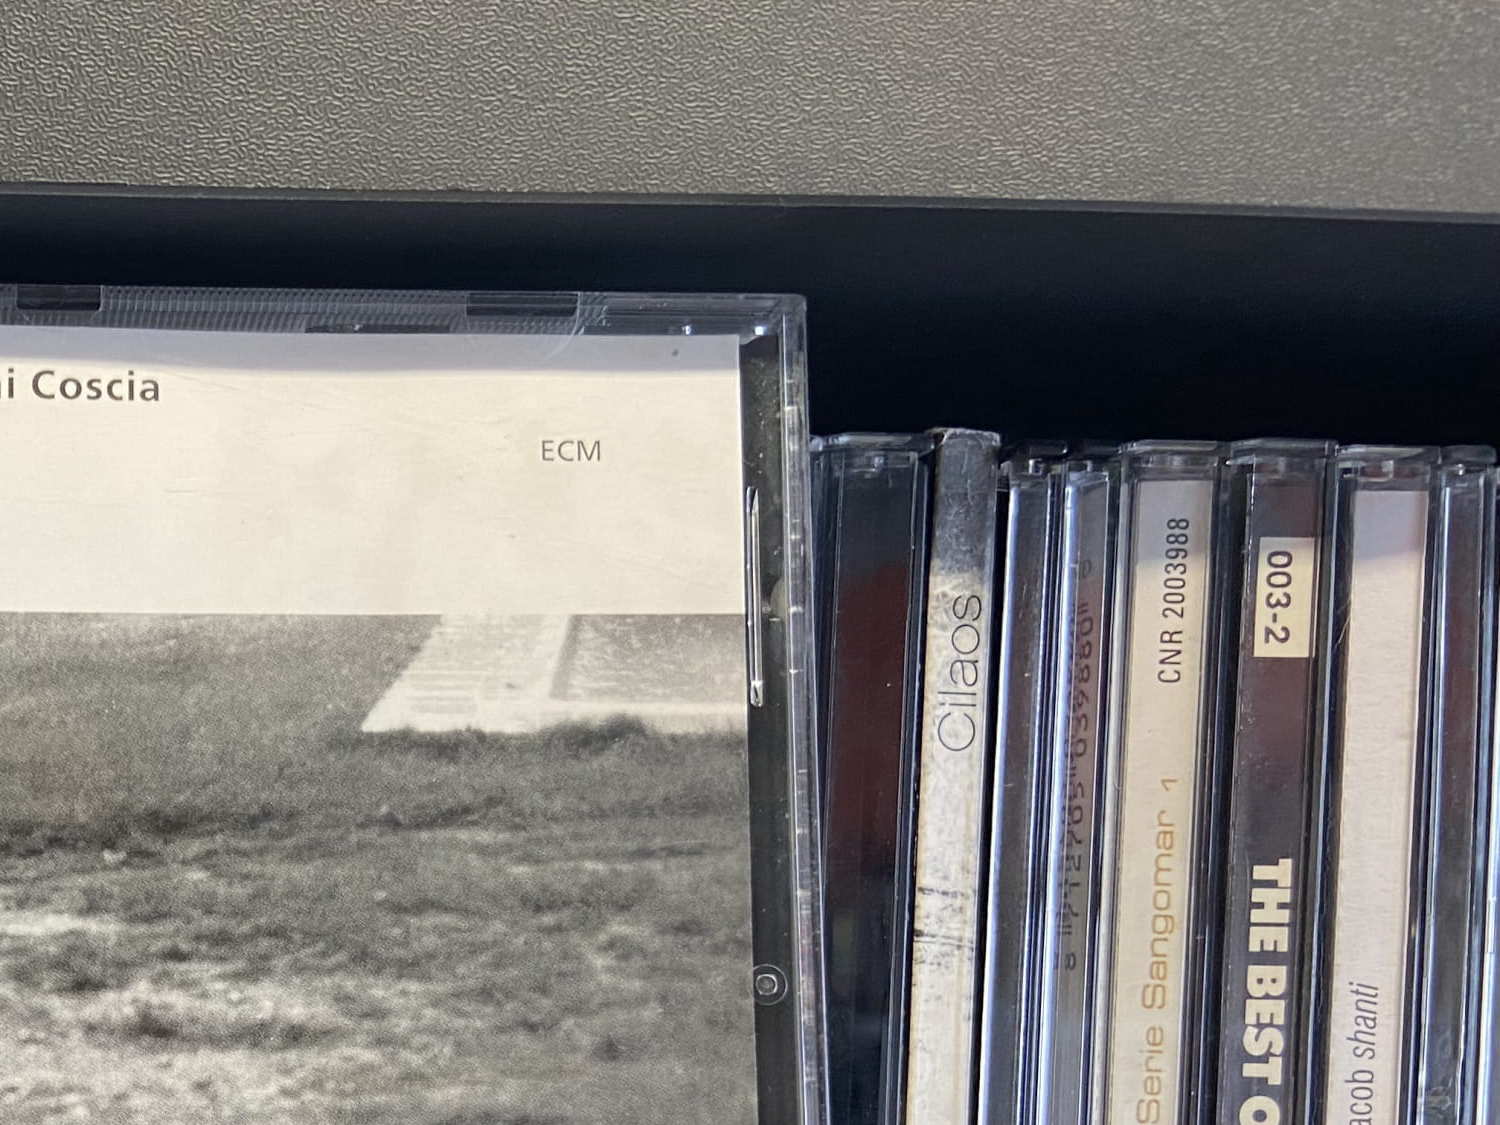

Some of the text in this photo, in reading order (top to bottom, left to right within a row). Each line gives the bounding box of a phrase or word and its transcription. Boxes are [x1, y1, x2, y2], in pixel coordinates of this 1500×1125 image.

[31, 369, 162, 403] Coscia
[541, 439, 601, 462] ECM
[1157, 517, 1190, 685] CNR 2003988
[1263, 549, 1294, 646] 003-2
[937, 593, 982, 753] Cilaos
[1142, 810, 1180, 1011] Sangomar
[1249, 857, 1294, 954] THE
[1243, 964, 1288, 1087] BEST
[1346, 981, 1381, 1060] shanti
